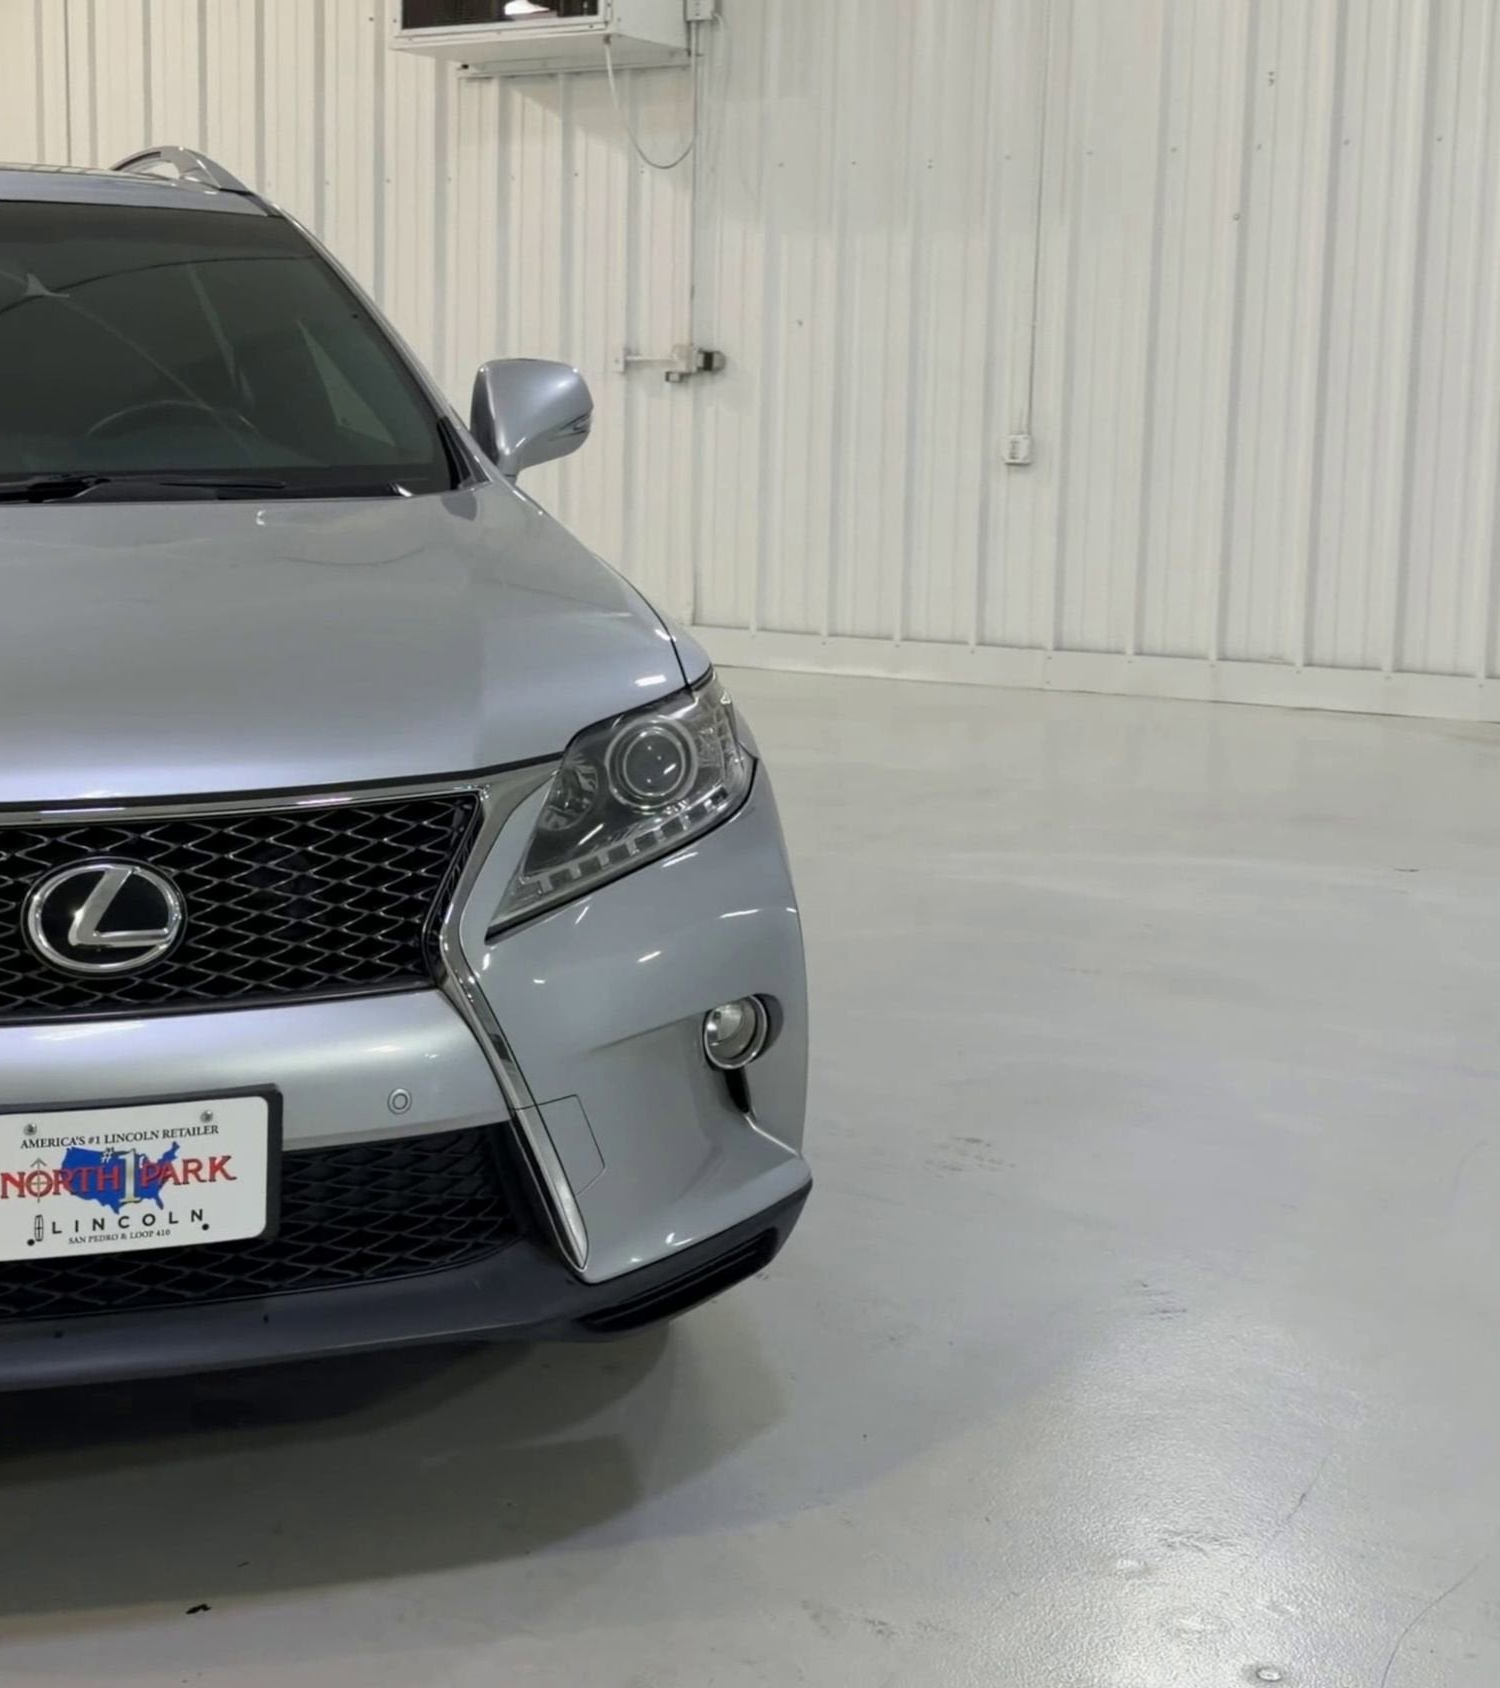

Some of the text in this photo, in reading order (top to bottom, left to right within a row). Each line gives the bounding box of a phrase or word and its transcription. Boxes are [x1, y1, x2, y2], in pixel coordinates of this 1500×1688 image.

[20, 1124, 219, 1149] AMERICA'S #1 LINCOLN RETAILER
[0, 1155, 237, 1199] NORTH PARK
[52, 1208, 204, 1235] LINCOLN
[68, 1227, 171, 1245] SAN PEDRO & LOOP 410
